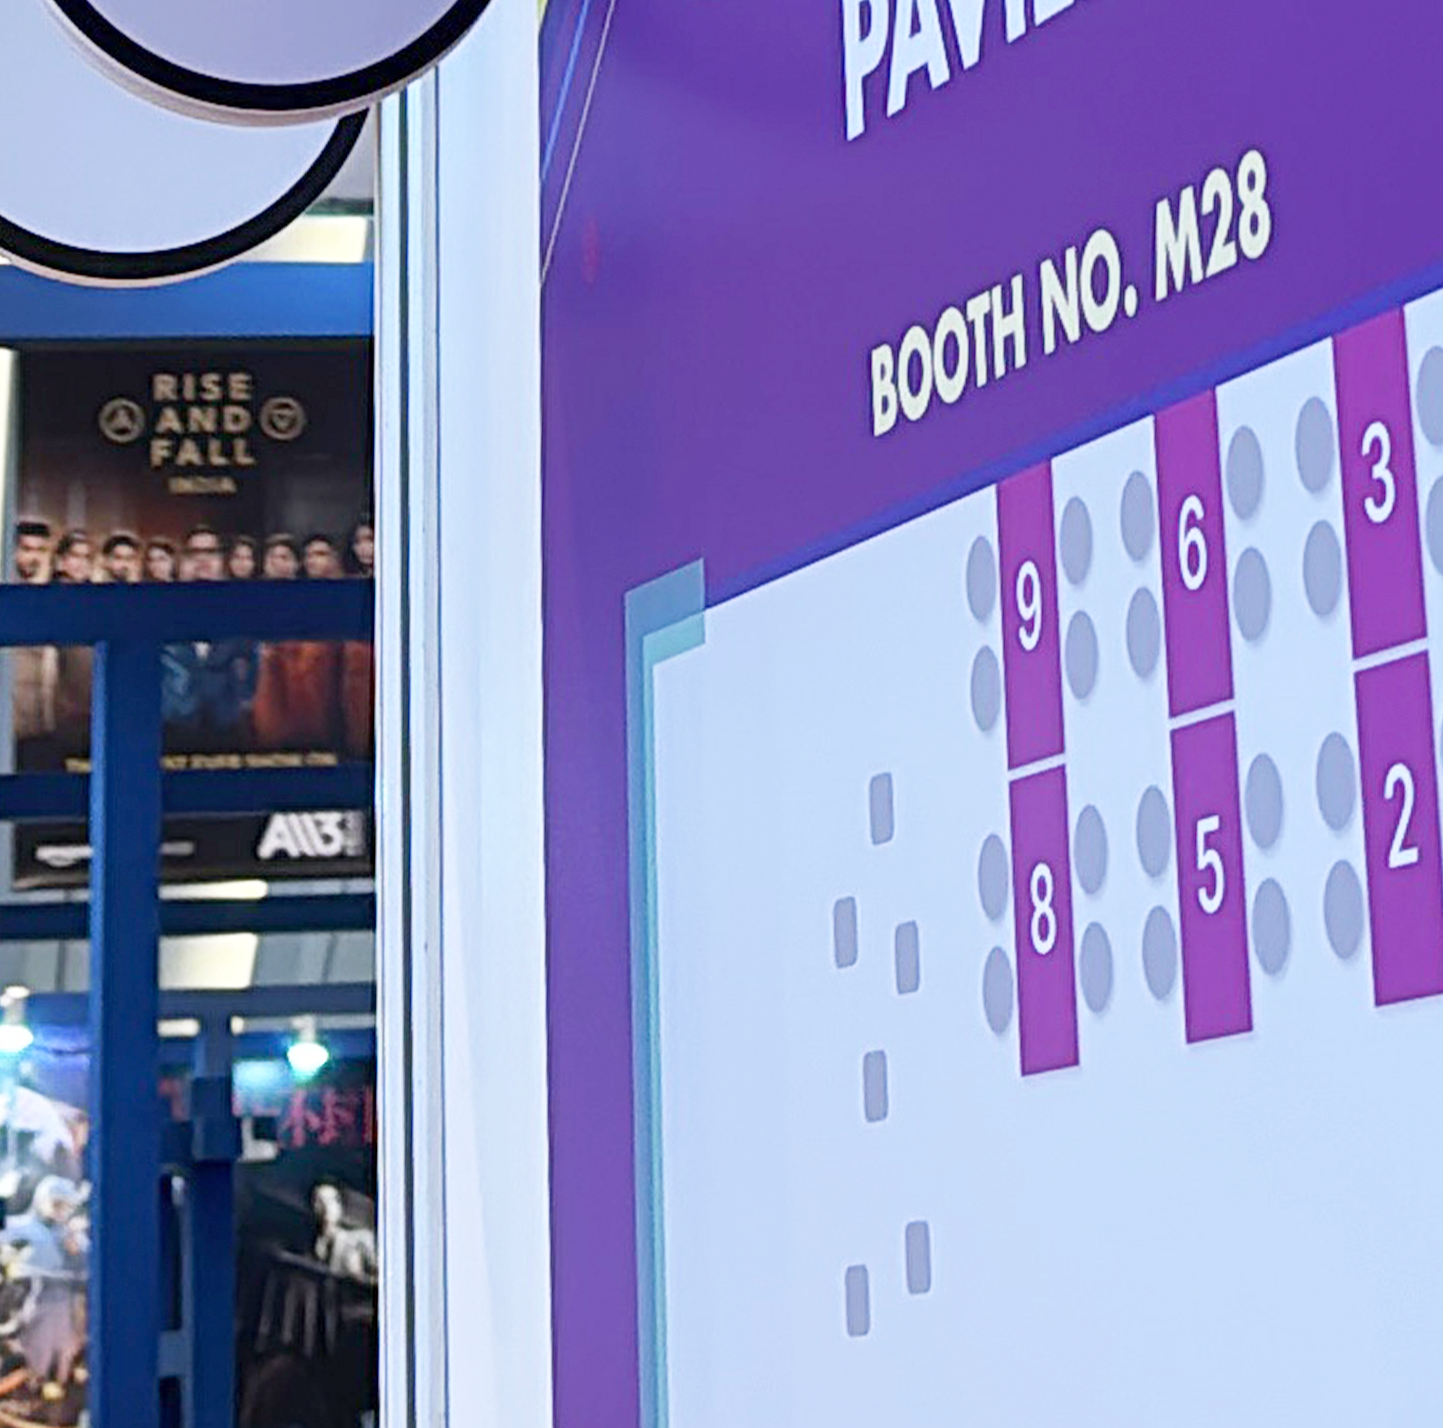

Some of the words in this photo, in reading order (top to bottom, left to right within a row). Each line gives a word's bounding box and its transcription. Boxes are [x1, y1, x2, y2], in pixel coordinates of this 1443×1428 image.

[870, 273, 1028, 438] BOOTH
[1039, 228, 1139, 356] NO.
[1154, 148, 1272, 302] M28
[153, 373, 252, 401] RISE
[156, 406, 252, 433] AND
[150, 439, 256, 467] FALL
[1360, 420, 1397, 524] 3
[1177, 494, 1209, 592] 6
[1016, 559, 1043, 652] 9
[1383, 761, 1420, 870] 2
[1029, 861, 1058, 956] 8
[1195, 814, 1226, 915] 5
